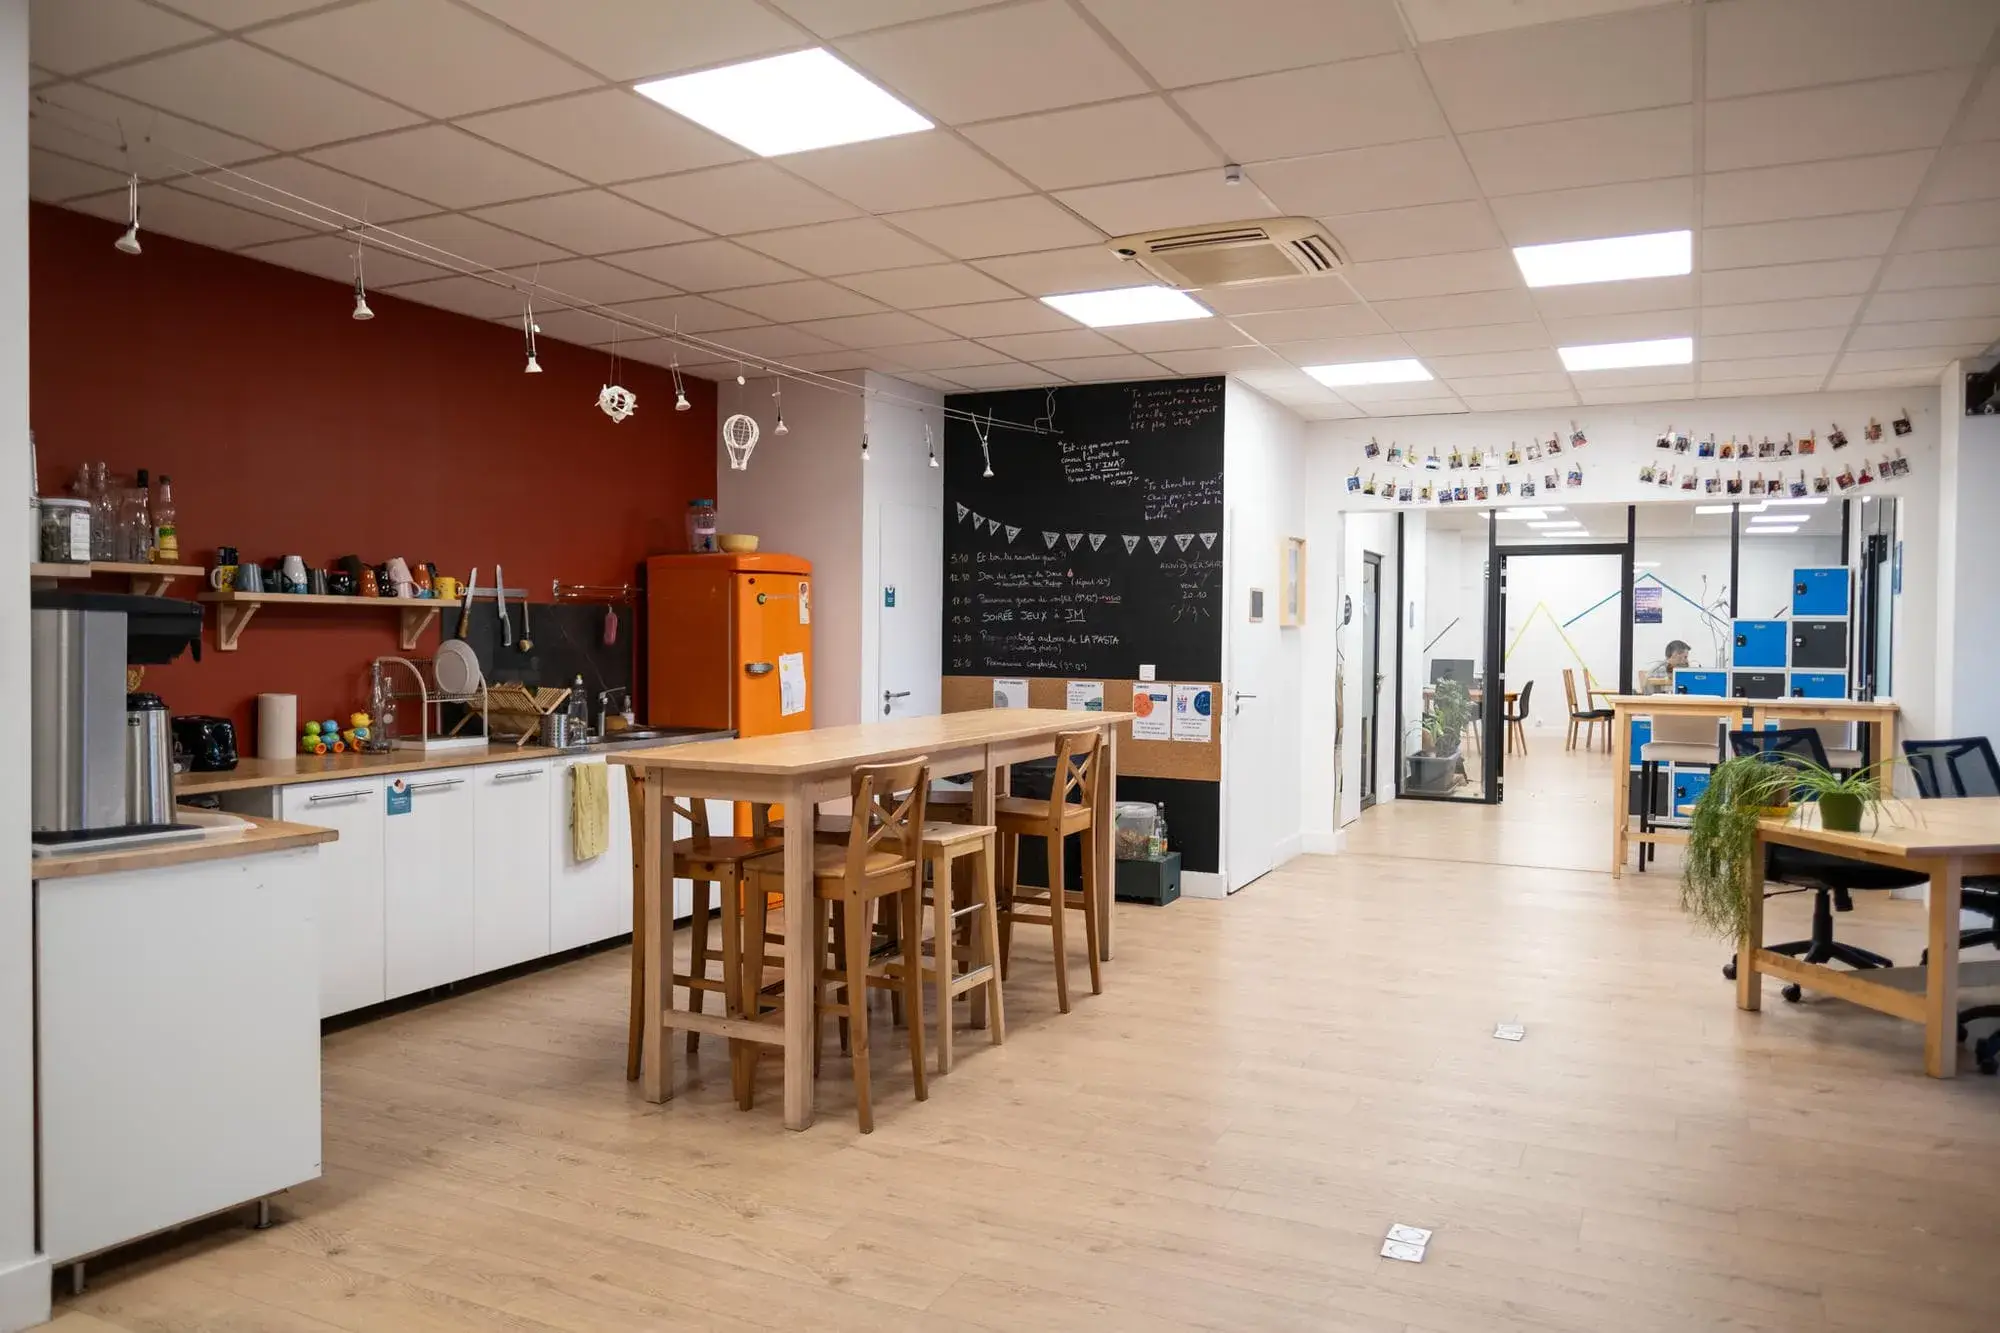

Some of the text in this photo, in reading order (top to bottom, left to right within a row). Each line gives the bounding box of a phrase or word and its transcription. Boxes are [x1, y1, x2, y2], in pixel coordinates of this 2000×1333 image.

[957, 504, 1214, 551] SAVE THE DATE
[1020, 610, 1048, 622] JEUX
[1080, 634, 1091, 644] LA
[1091, 634, 1120, 645] PASTA
